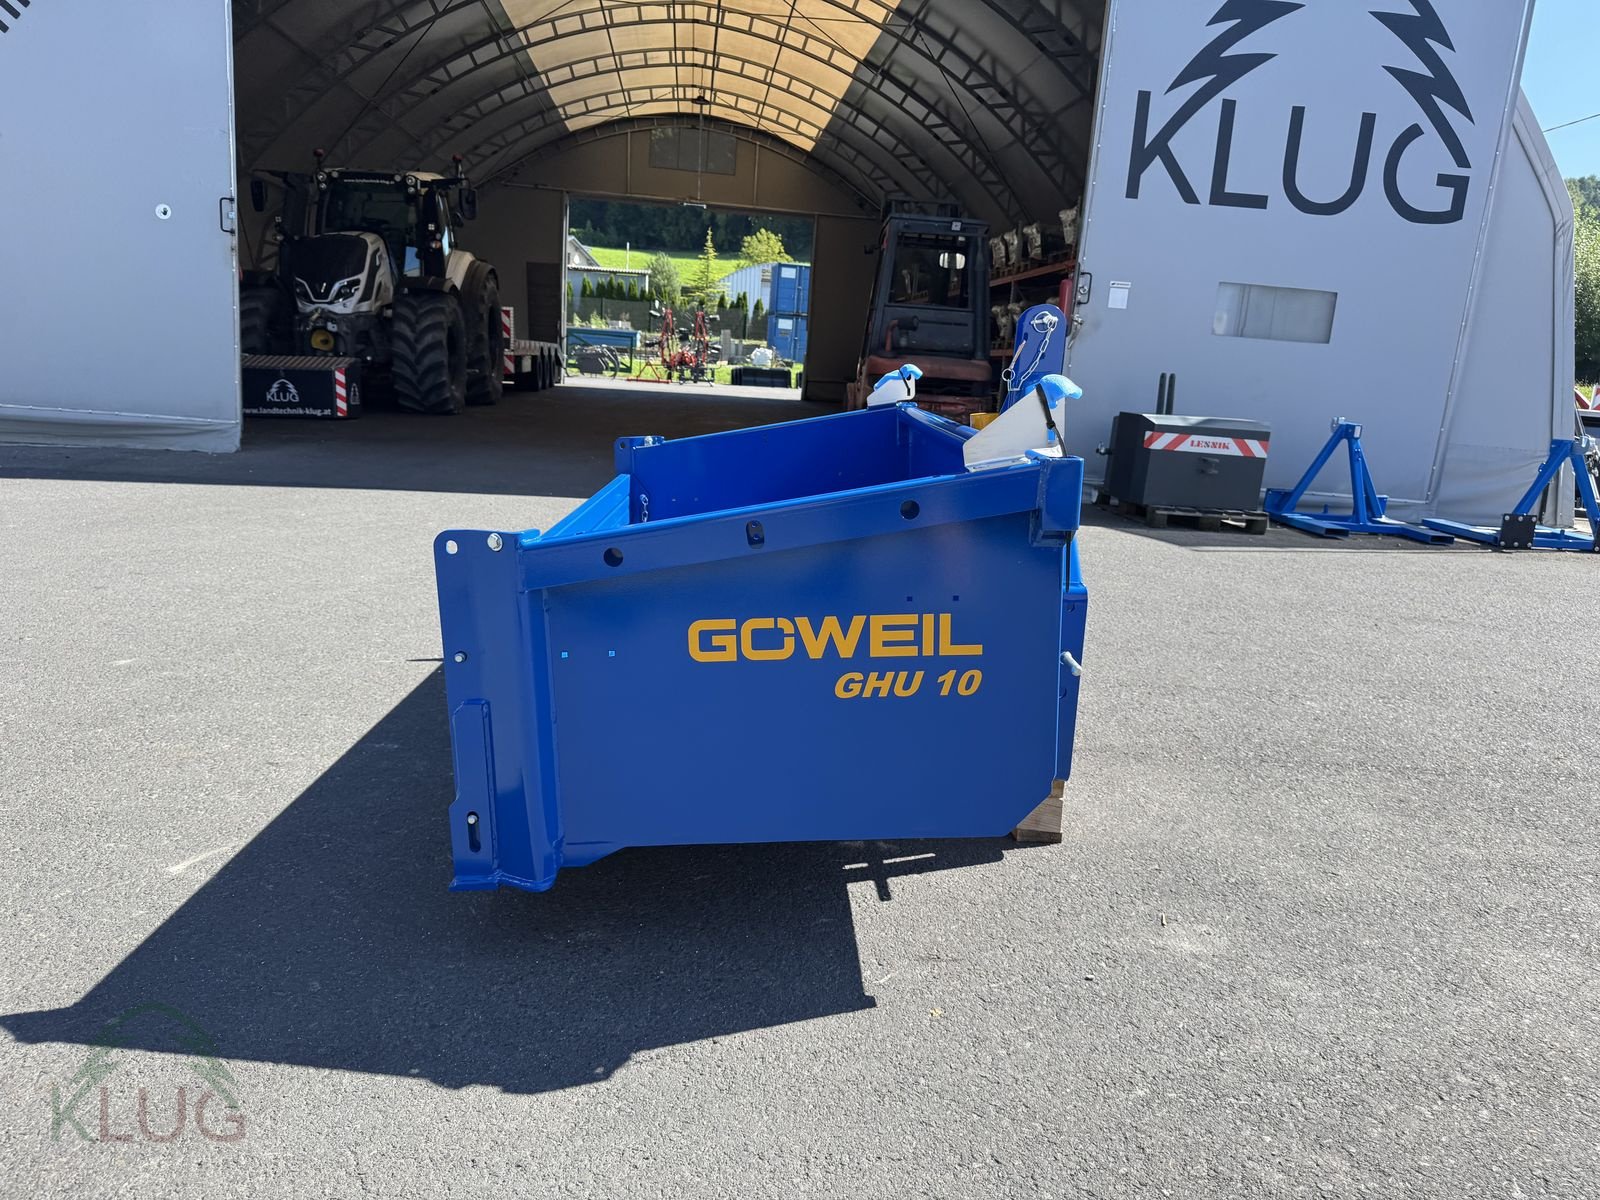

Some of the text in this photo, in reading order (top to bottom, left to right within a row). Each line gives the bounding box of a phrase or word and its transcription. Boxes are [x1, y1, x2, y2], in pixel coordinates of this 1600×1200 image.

[1125, 90, 1472, 225] KLUG
[266, 391, 299, 402] KLUG
[834, 668, 983, 699] GHU 10
